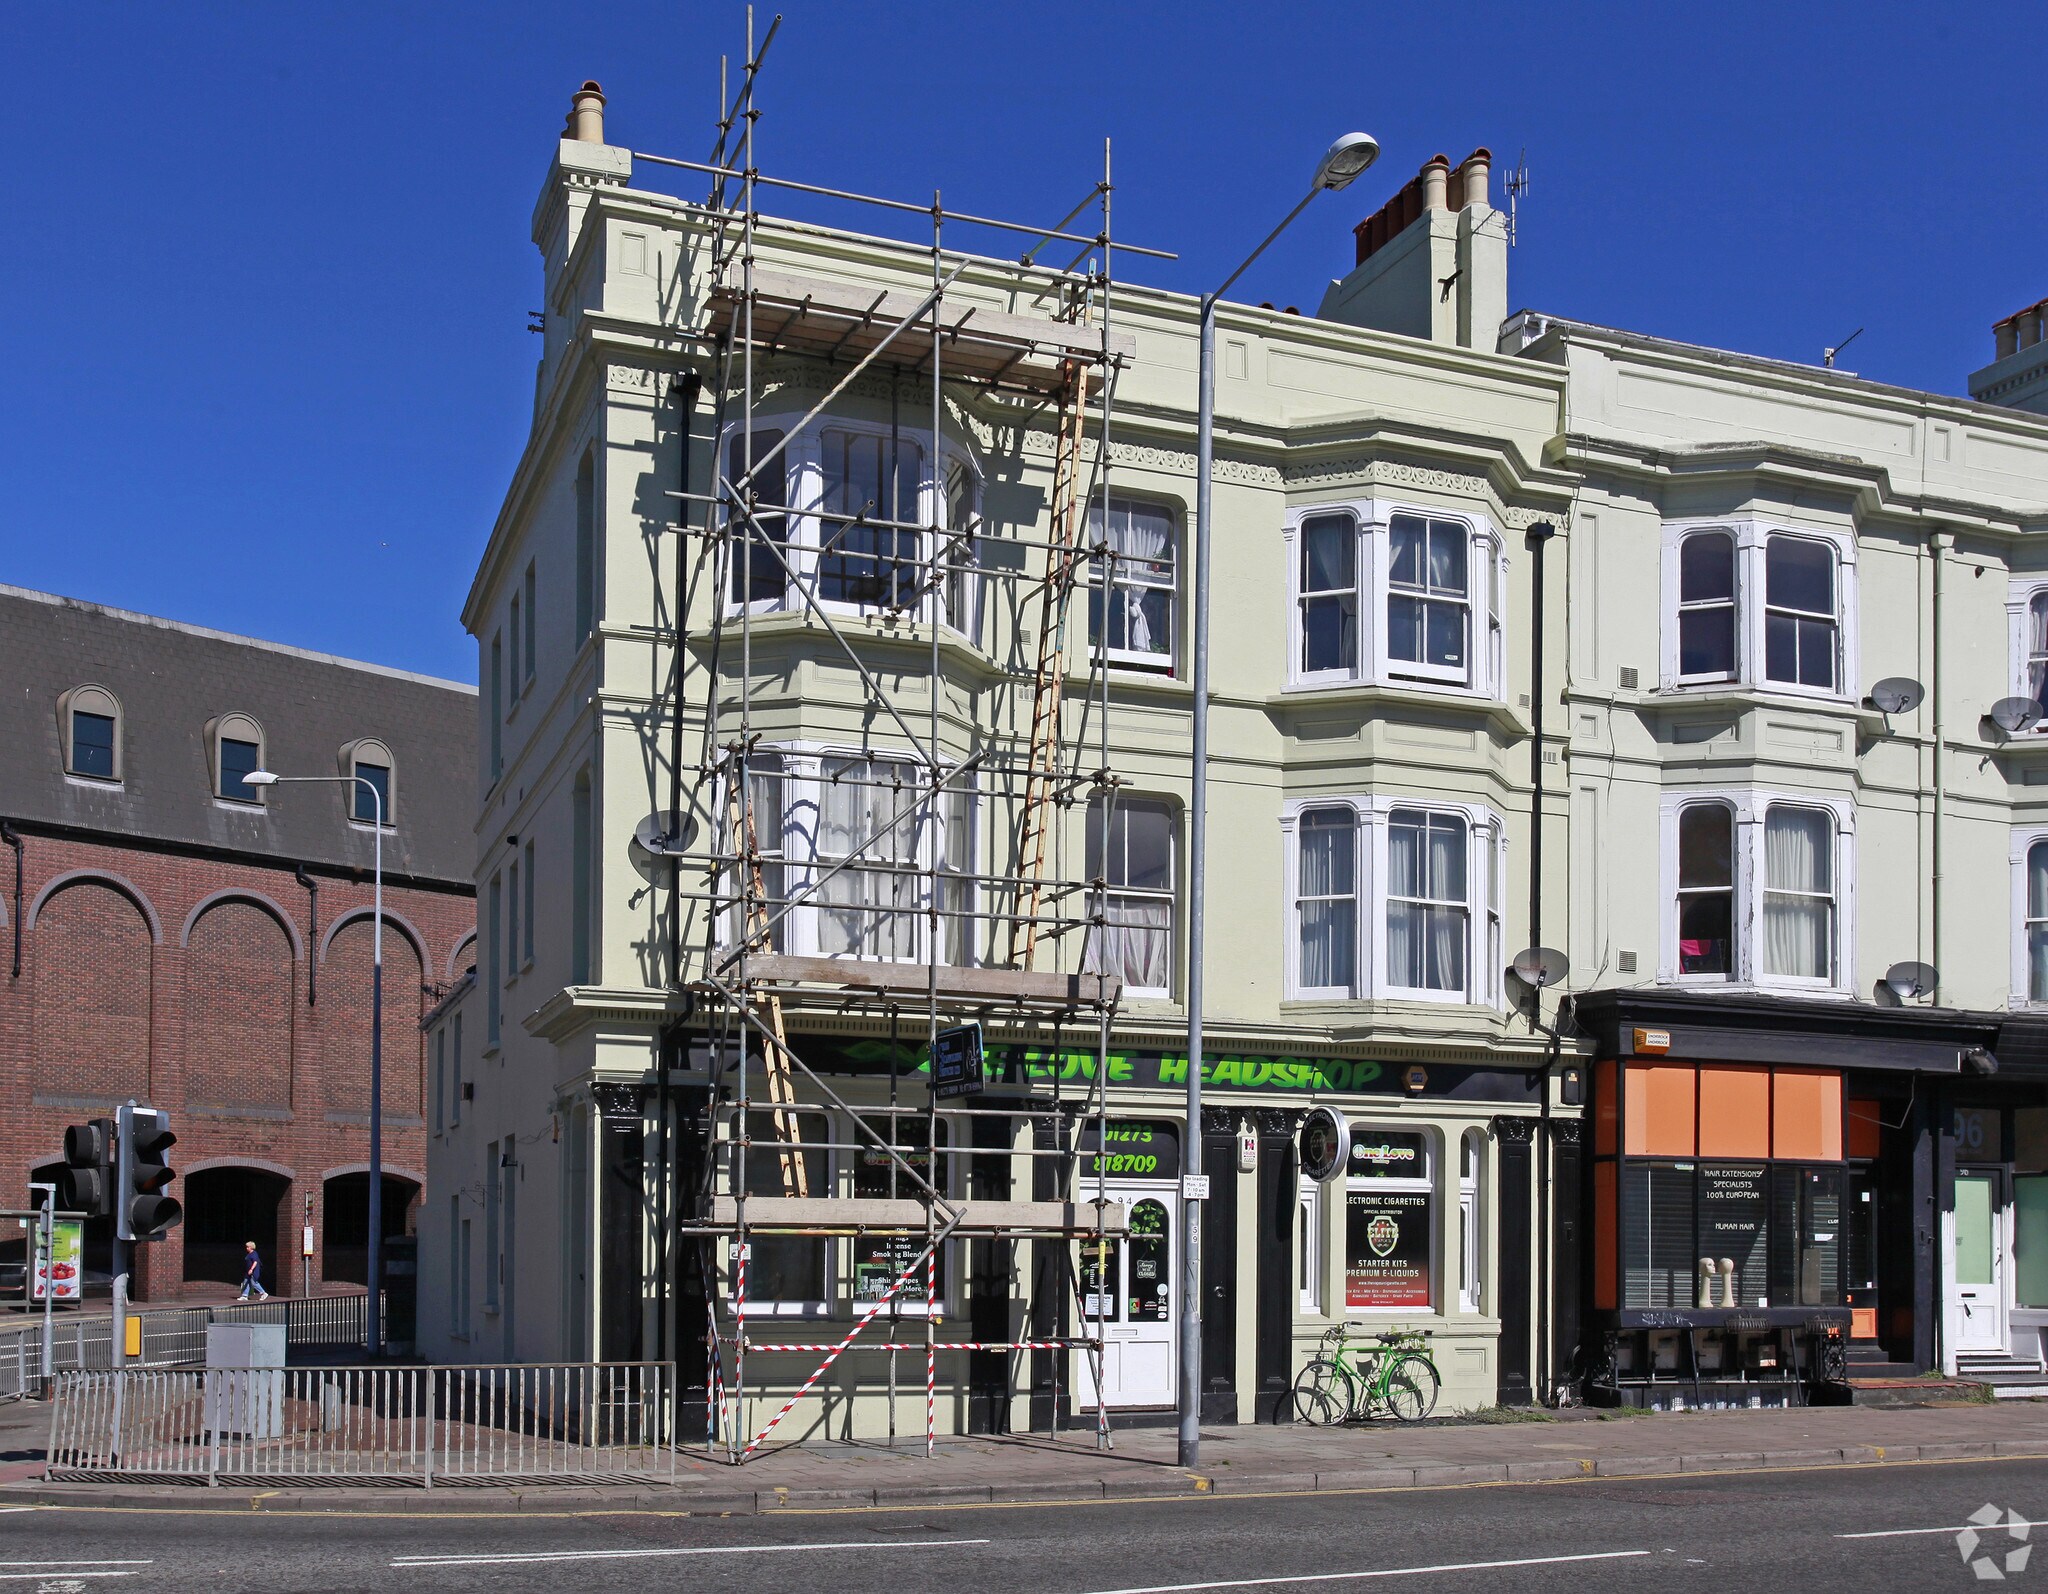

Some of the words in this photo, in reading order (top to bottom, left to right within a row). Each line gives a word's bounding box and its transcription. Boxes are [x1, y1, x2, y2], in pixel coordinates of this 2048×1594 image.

[1024, 1046, 1137, 1081] LOVE
[1105, 1123, 1153, 1143] 01273
[1381, 1144, 1415, 1160] Love
[1721, 1170, 1761, 1178] EXTENSIONS
[1713, 1180, 1753, 1188] SPECIALISTS
[1725, 1191, 1760, 1199] EUROPEAN
[1384, 1197, 1425, 1206] CIGARETTES
[1367, 1227, 1399, 1239] ELITE
[1358, 1259, 1390, 1267] STARTER
[1391, 1260, 1408, 1268] KITS
[1346, 1269, 1380, 1277] PREMIUM
[1382, 1269, 1420, 1277] E-LIQUIDS
